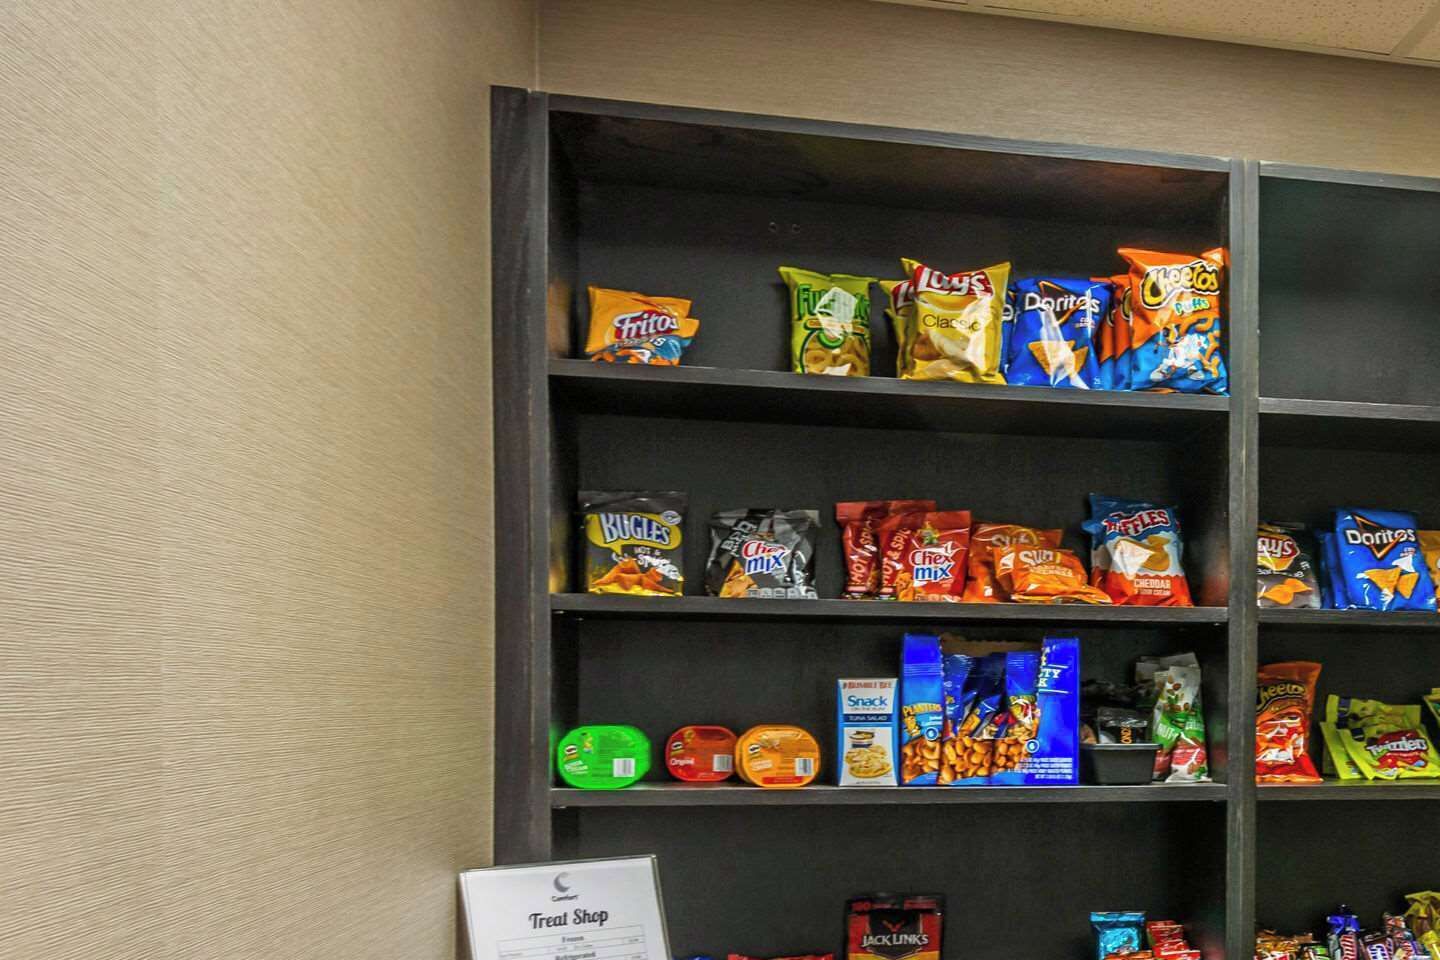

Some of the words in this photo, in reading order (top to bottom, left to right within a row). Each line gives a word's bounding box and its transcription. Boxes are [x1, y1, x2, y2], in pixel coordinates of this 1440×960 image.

[1142, 262, 1219, 308] Cheetos
[1025, 293, 1100, 314] Doritos
[614, 309, 680, 340] Fritos
[922, 314, 980, 332] Classic
[600, 511, 670, 545] BUGLES
[1345, 528, 1416, 546] Doritos
[890, 527, 912, 551] SPIC
[1257, 537, 1294, 558] ay's
[745, 551, 786, 576] mix
[910, 550, 954, 566] Chex
[914, 565, 953, 581] mix
[1134, 578, 1171, 589] CHEDDAR
[847, 695, 888, 707] Snack
[528, 911, 568, 930] Treat
[573, 908, 609, 927] Shop
[861, 934, 893, 948] JACK
